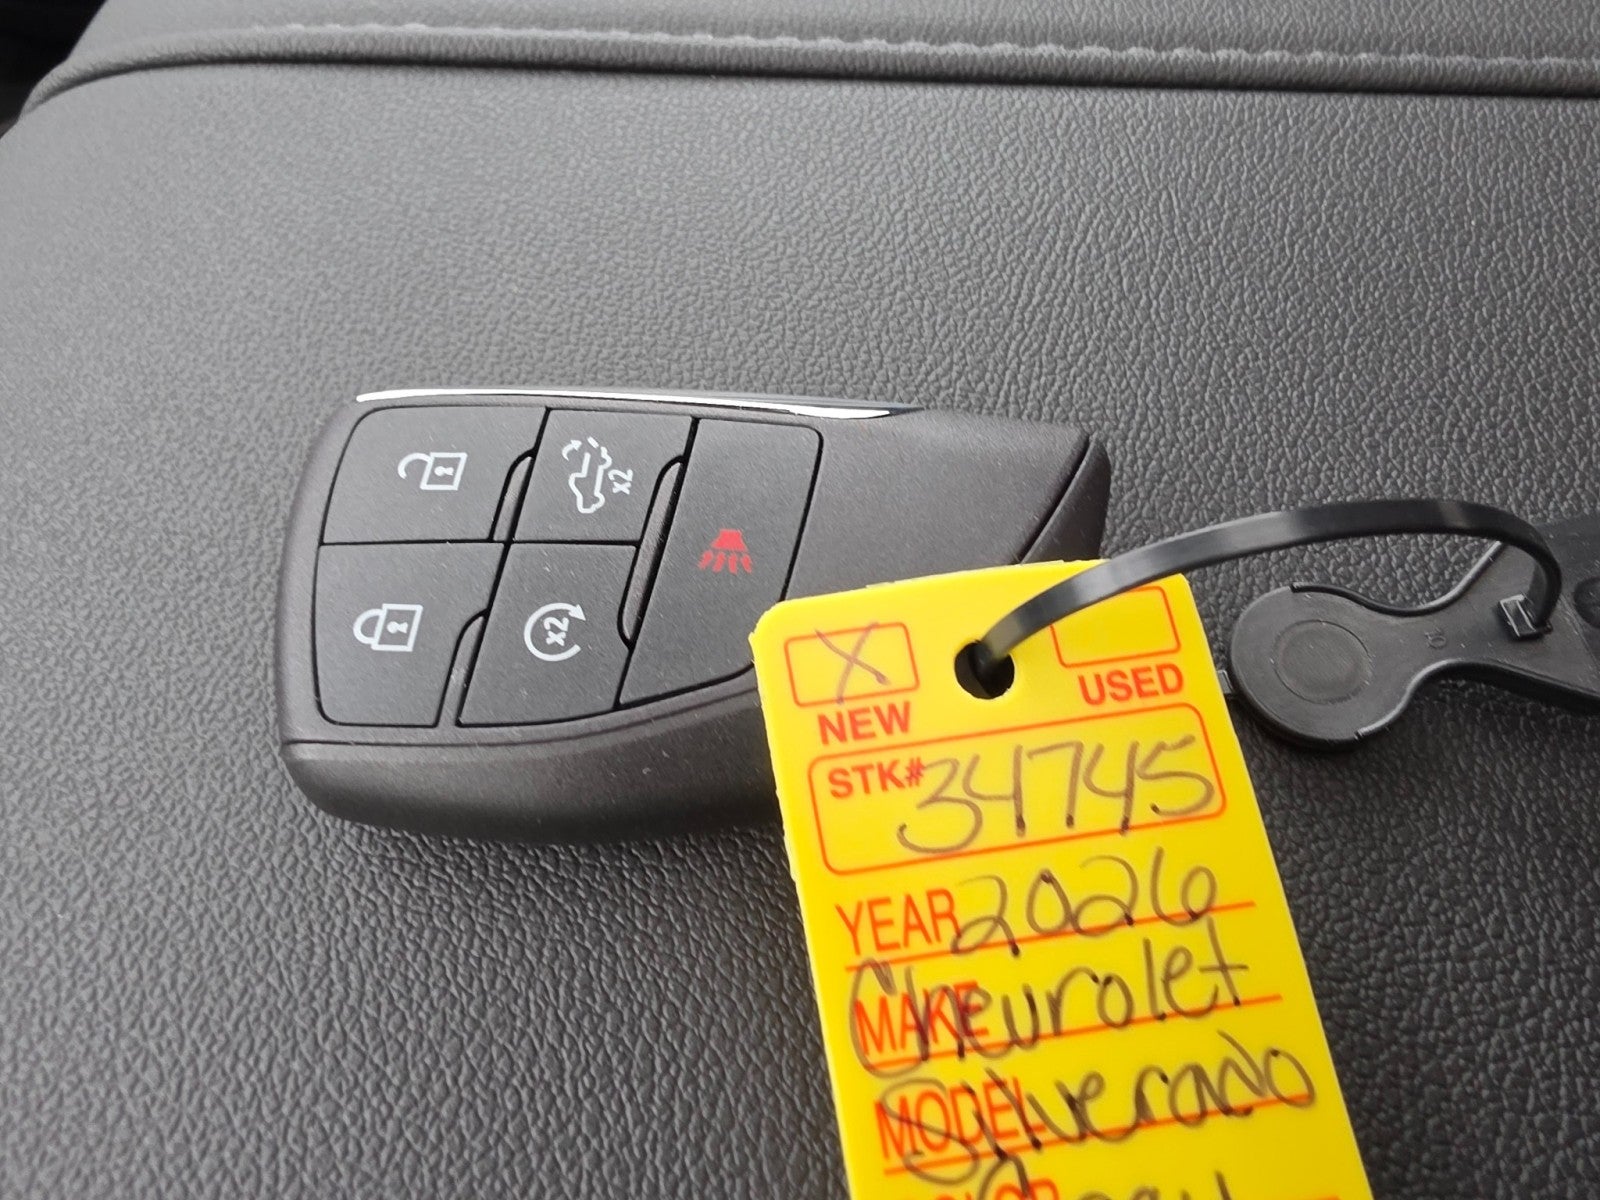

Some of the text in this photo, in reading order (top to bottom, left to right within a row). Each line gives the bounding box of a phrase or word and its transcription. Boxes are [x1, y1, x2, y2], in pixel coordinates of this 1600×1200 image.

[817, 702, 912, 745] NEW
[1078, 662, 1184, 706] USED
[827, 757, 925, 799] STK#
[896, 734, 1216, 855] 34745
[834, 887, 962, 957] YEAR
[951, 846, 1218, 957] 2026
[849, 917, 1250, 1078] Chevrolet
[854, 979, 990, 1057] MAKE
[873, 1075, 1048, 1161] MODEL
[879, 1030, 1316, 1187] Silverado
